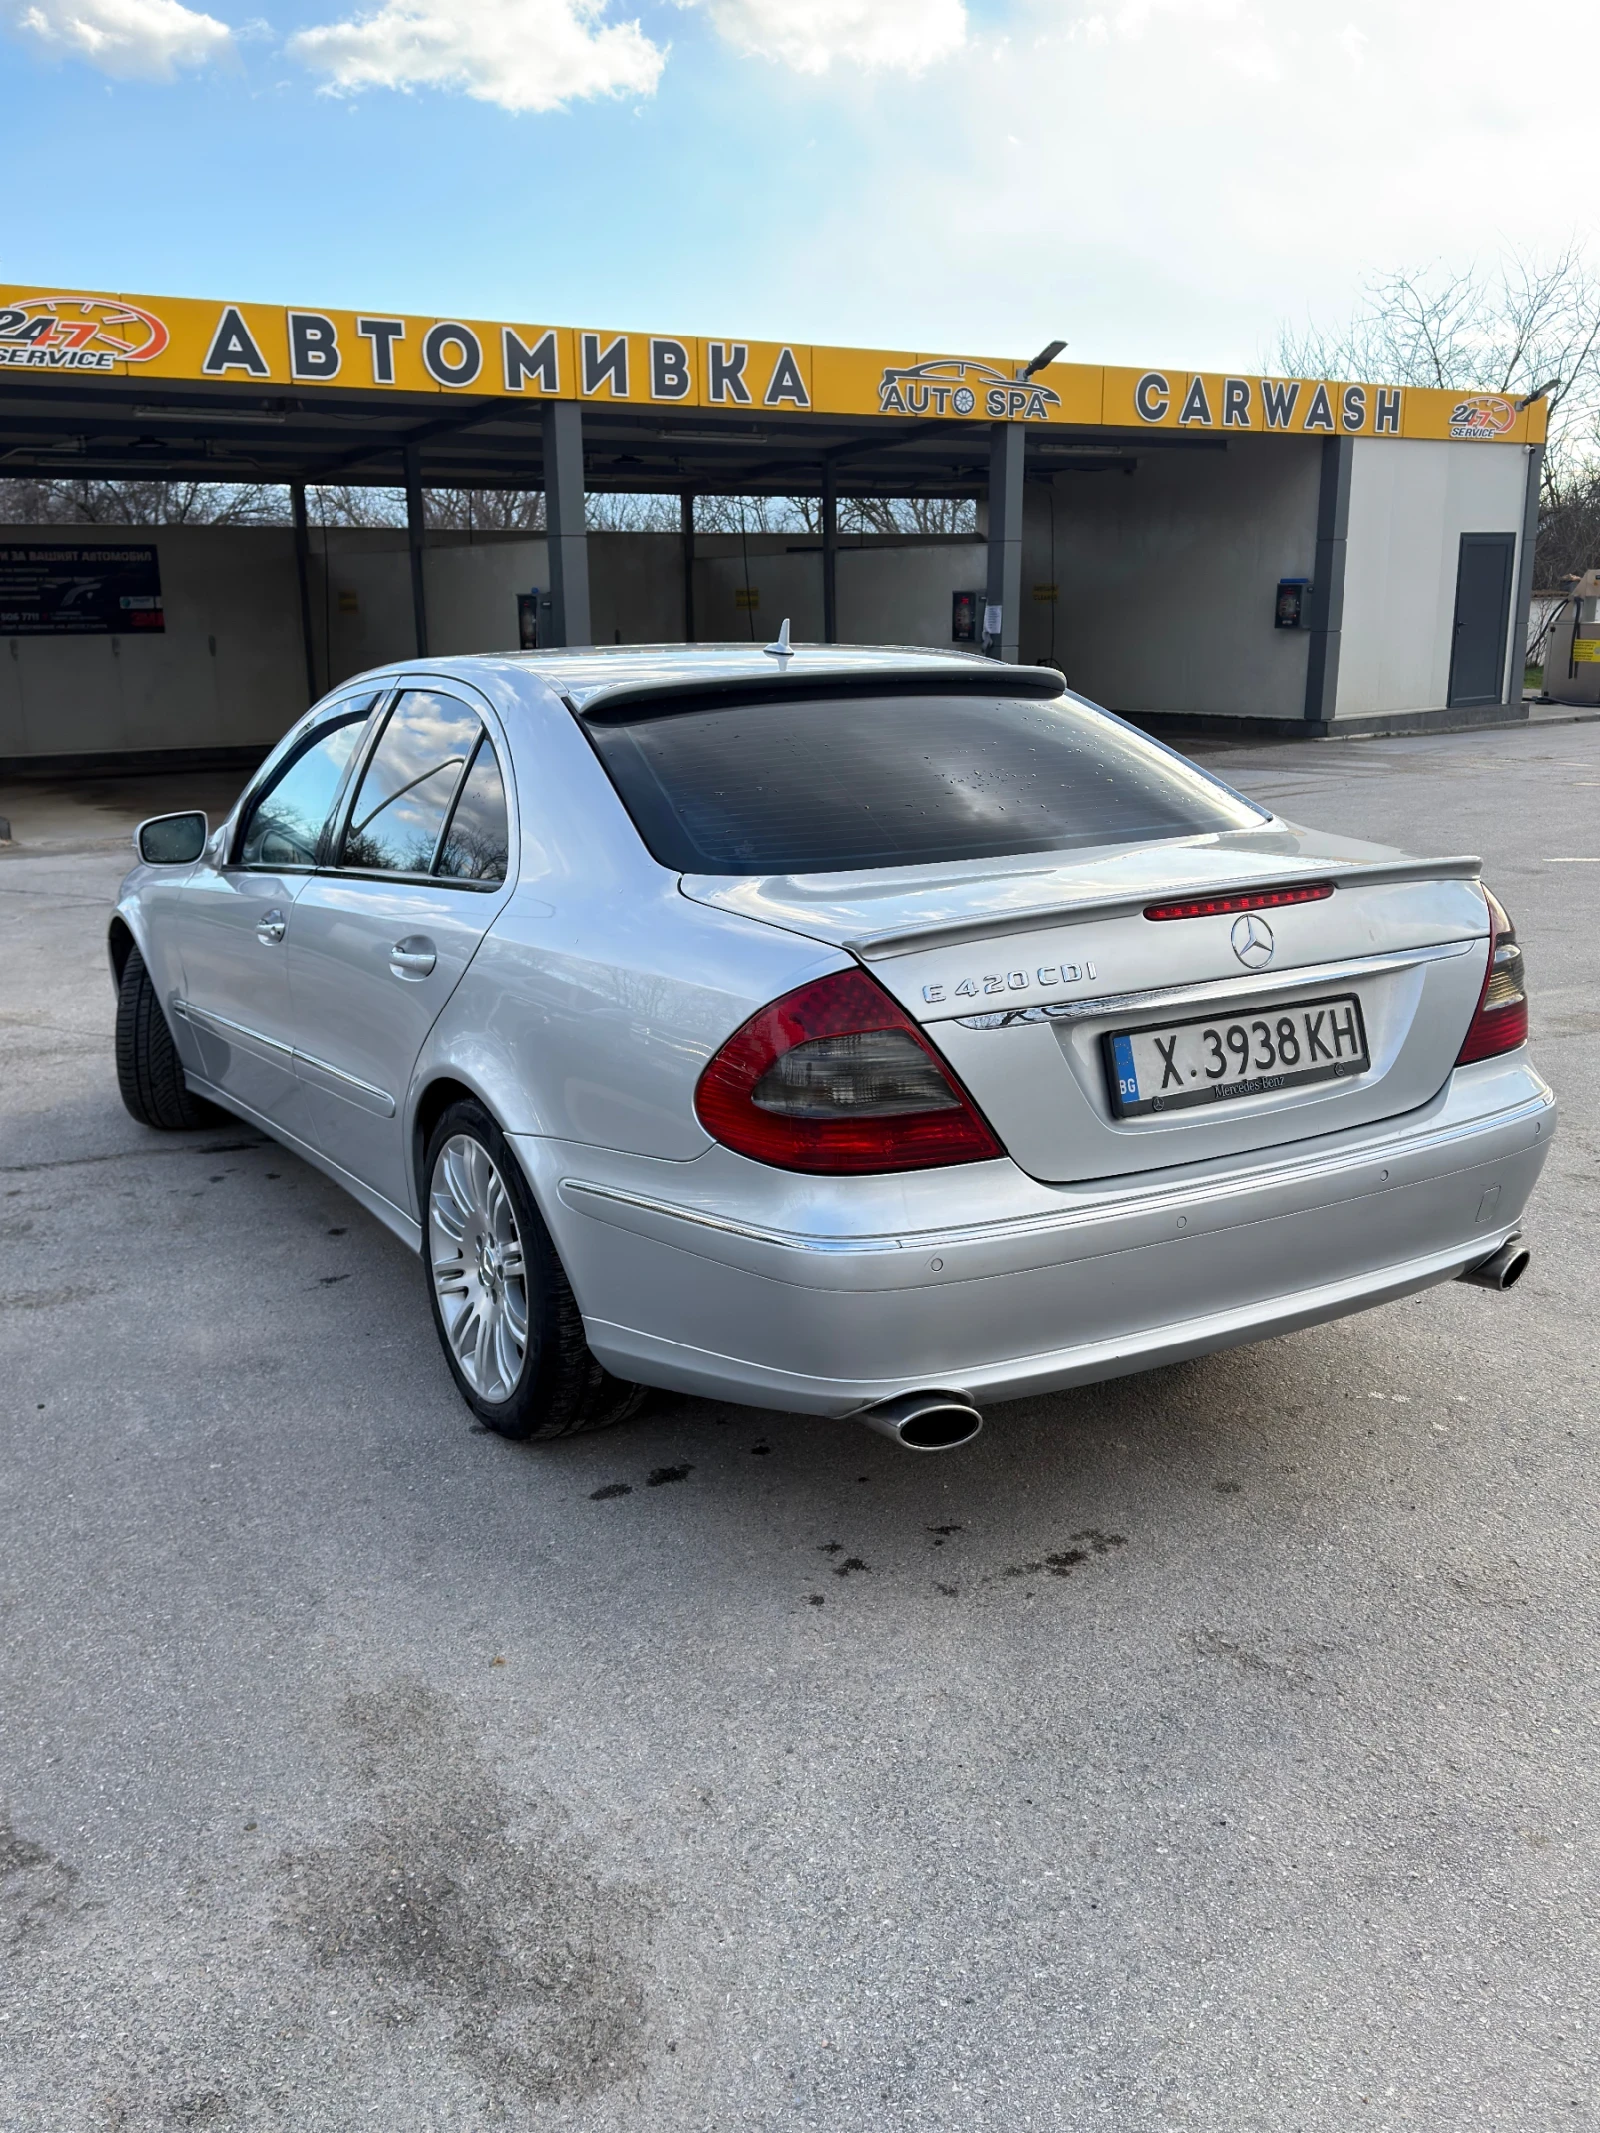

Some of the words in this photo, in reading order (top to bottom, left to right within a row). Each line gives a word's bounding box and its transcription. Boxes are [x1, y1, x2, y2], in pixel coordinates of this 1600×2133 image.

[203, 305, 811, 407] АВТОМИВКА
[880, 384, 975, 415] AUTO
[986, 389, 1049, 419] SPA
[1134, 371, 1402, 434] CARWASH
[1450, 427, 1496, 438] SERVICE
[82, 551, 152, 561] АВТОМОБИЛ
[922, 984, 946, 1003] E
[955, 970, 1029, 997] 420
[1037, 961, 1097, 986] CDI
[1203, 1016, 1300, 1078] 3938
[1119, 1078, 1136, 1095] BG
